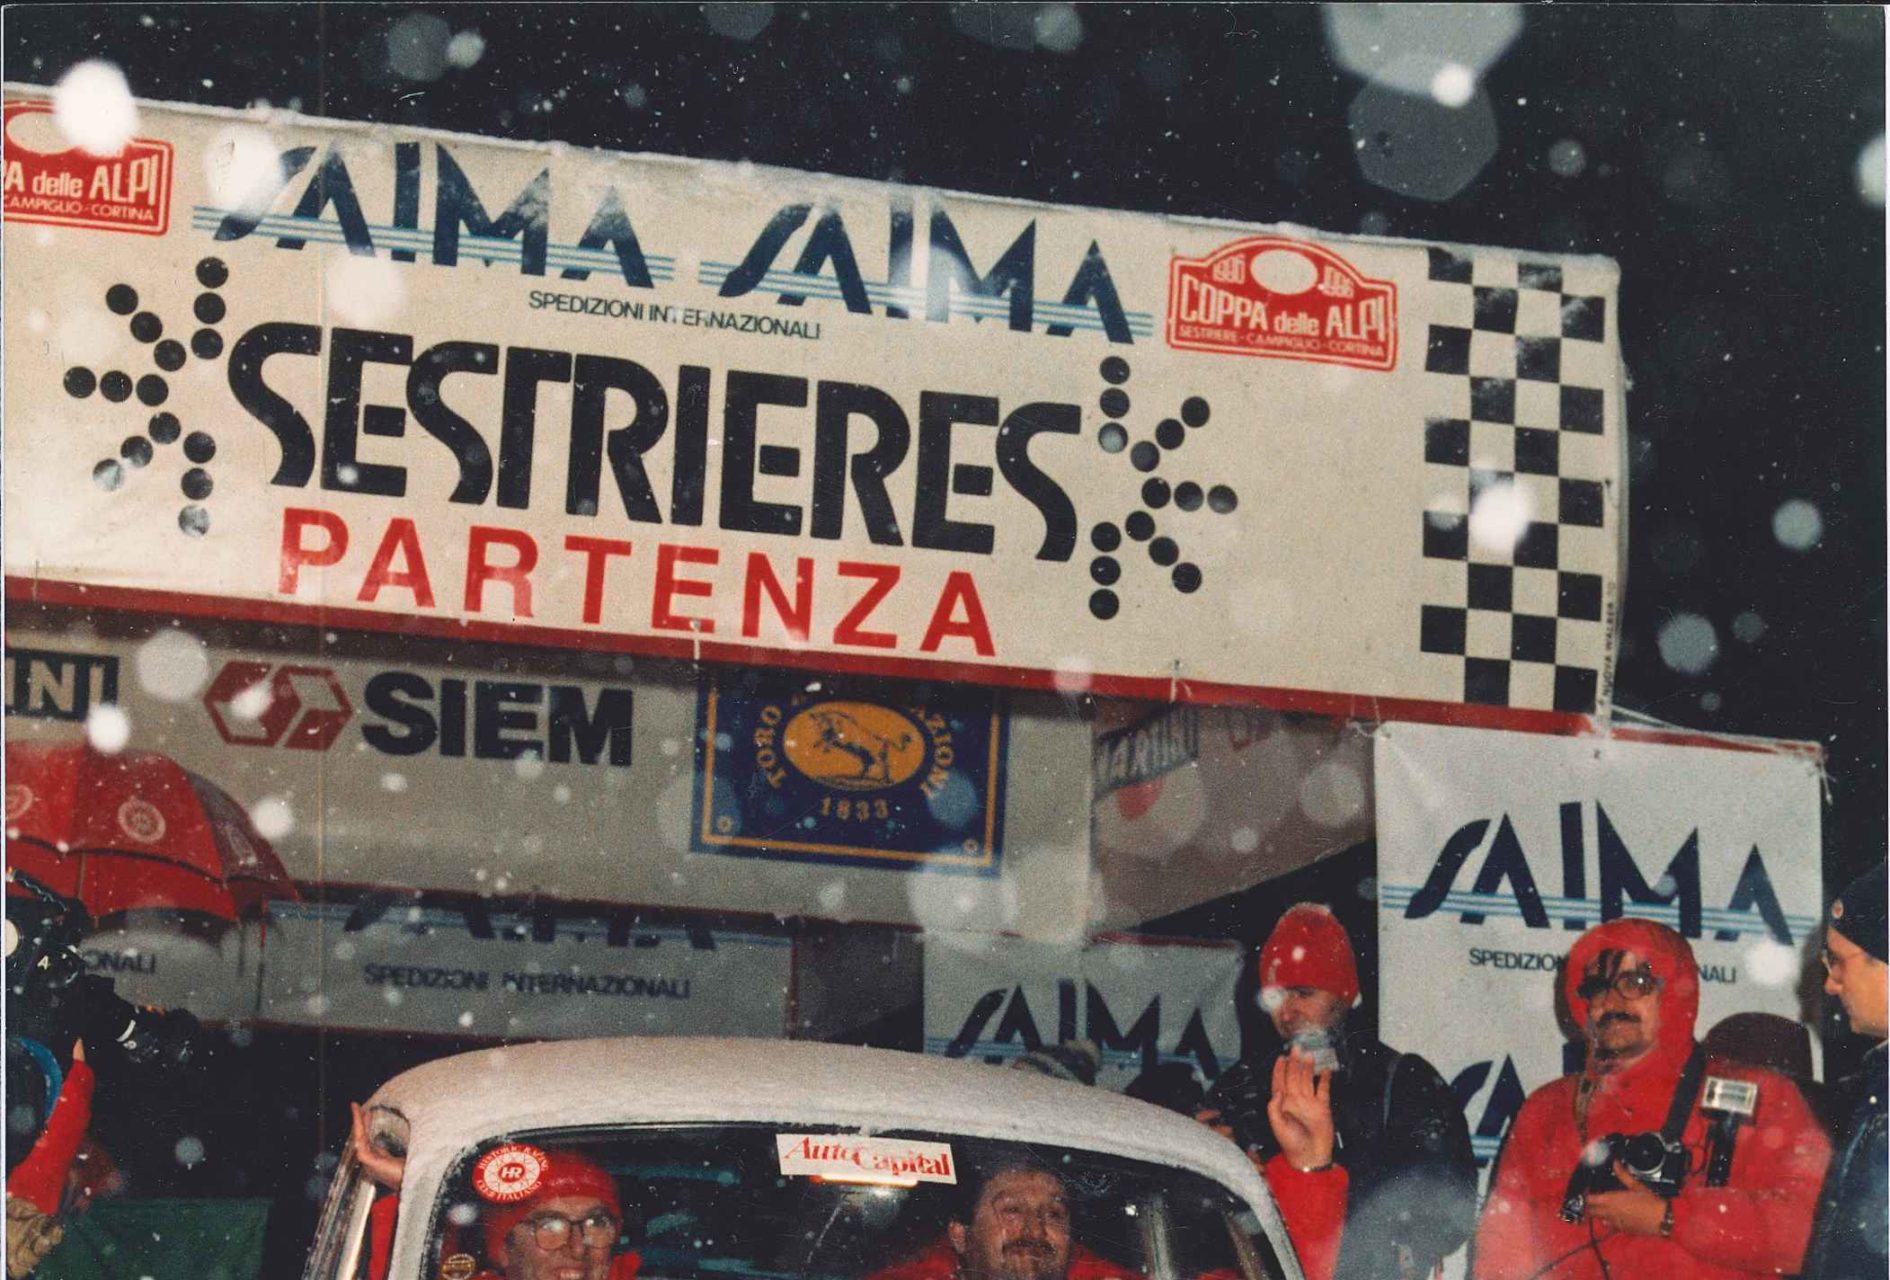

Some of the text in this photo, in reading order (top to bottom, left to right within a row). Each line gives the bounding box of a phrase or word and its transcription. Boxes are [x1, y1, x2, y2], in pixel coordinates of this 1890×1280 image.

[32, 170, 83, 198] delle
[89, 154, 160, 206] ALPI
[91, 202, 154, 221] CORTINA
[528, 290, 821, 340] SPEDIZIONI INTERNAZIONALI
[1180, 274, 1385, 342] COPPA delle ALPI
[227, 321, 1082, 562] SESTRIERES
[278, 507, 996, 657] PARTENZA
[361, 671, 633, 767] SIEM
[363, 962, 489, 991] SPEDIZIONI
[500, 1166, 523, 1179] HR
